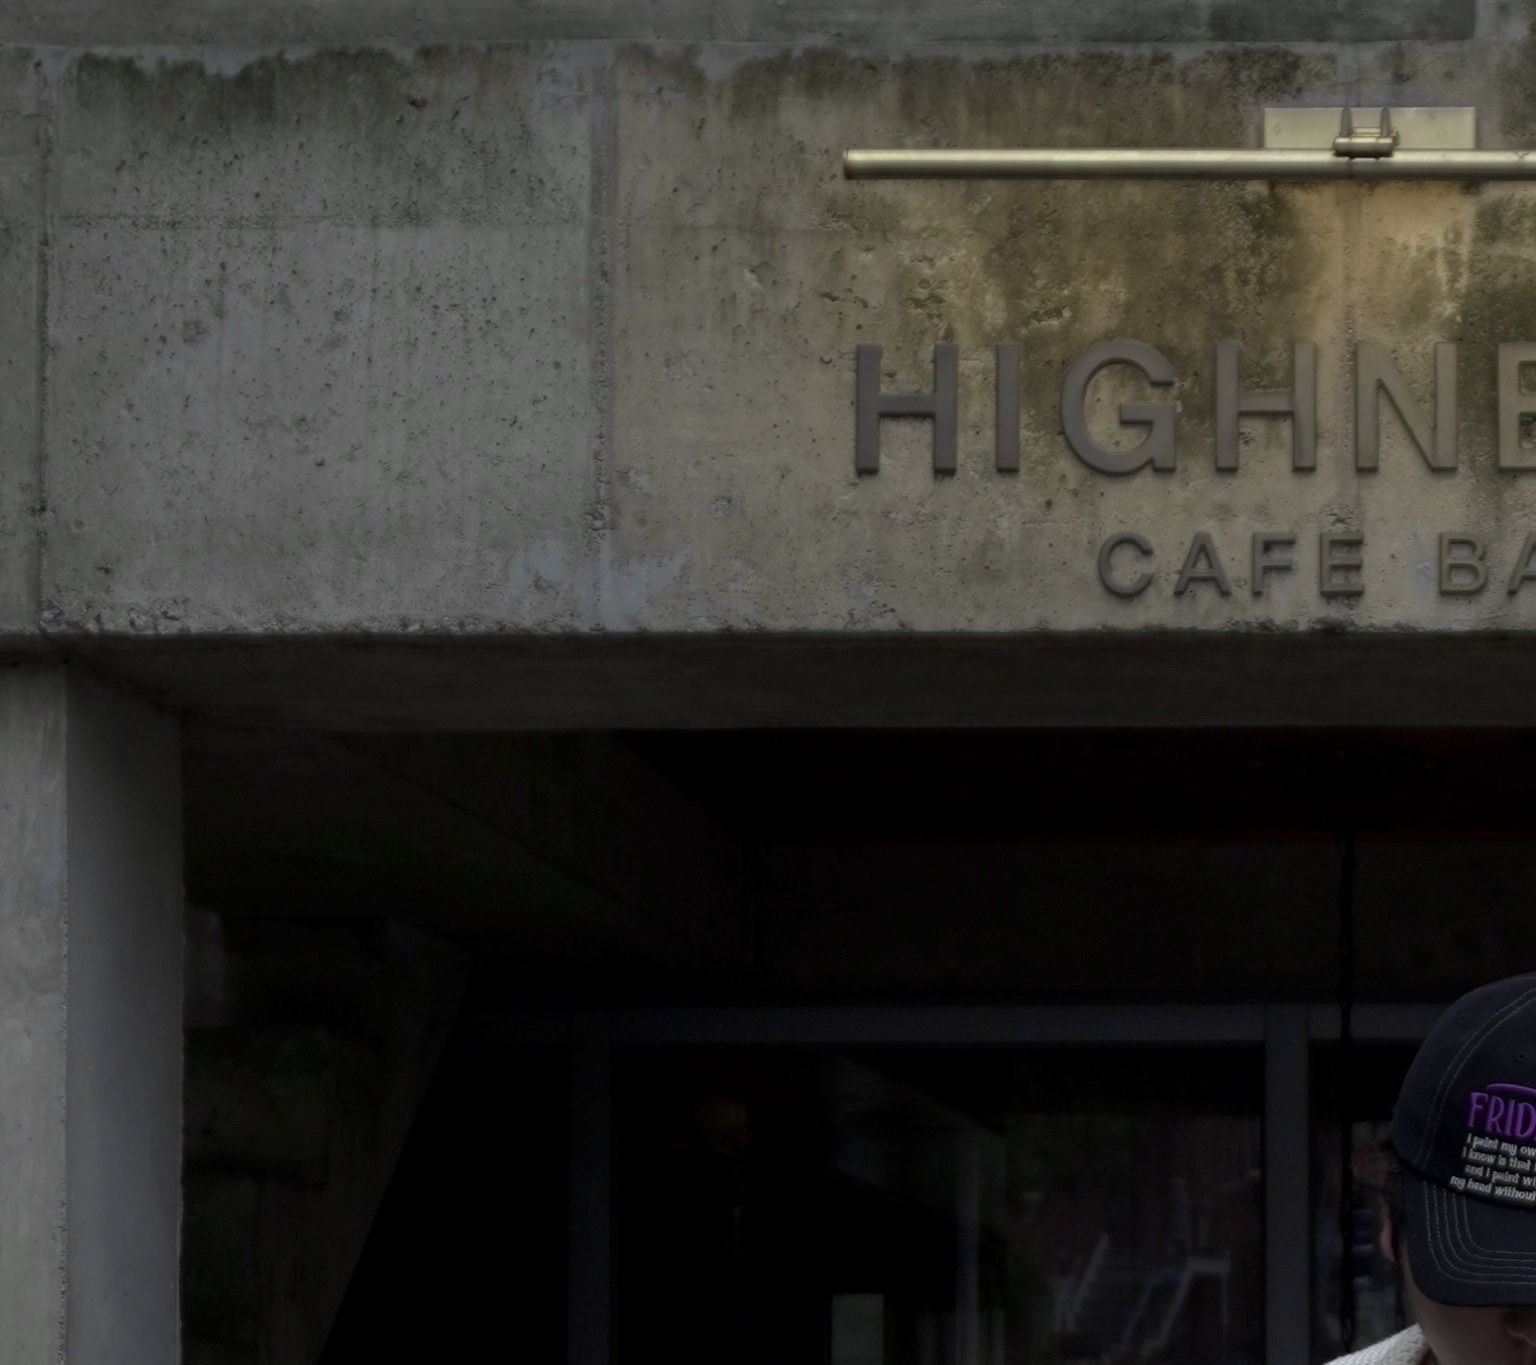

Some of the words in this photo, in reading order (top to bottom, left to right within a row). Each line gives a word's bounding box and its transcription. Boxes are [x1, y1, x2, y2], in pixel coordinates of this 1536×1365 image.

[1098, 531, 1366, 597] CAFE
[1472, 1135, 1499, 1150] paint
[1500, 1141, 1518, 1156] my
[1468, 1148, 1497, 1163] know
[1497, 1155, 1507, 1166] is
[1508, 1157, 1532, 1171] that
[1464, 1164, 1484, 1176] and
[1491, 1170, 1520, 1184] paint
[1449, 1175, 1466, 1190] my
[1467, 1178, 1492, 1193] head
[1494, 1184, 1536, 1200] without
